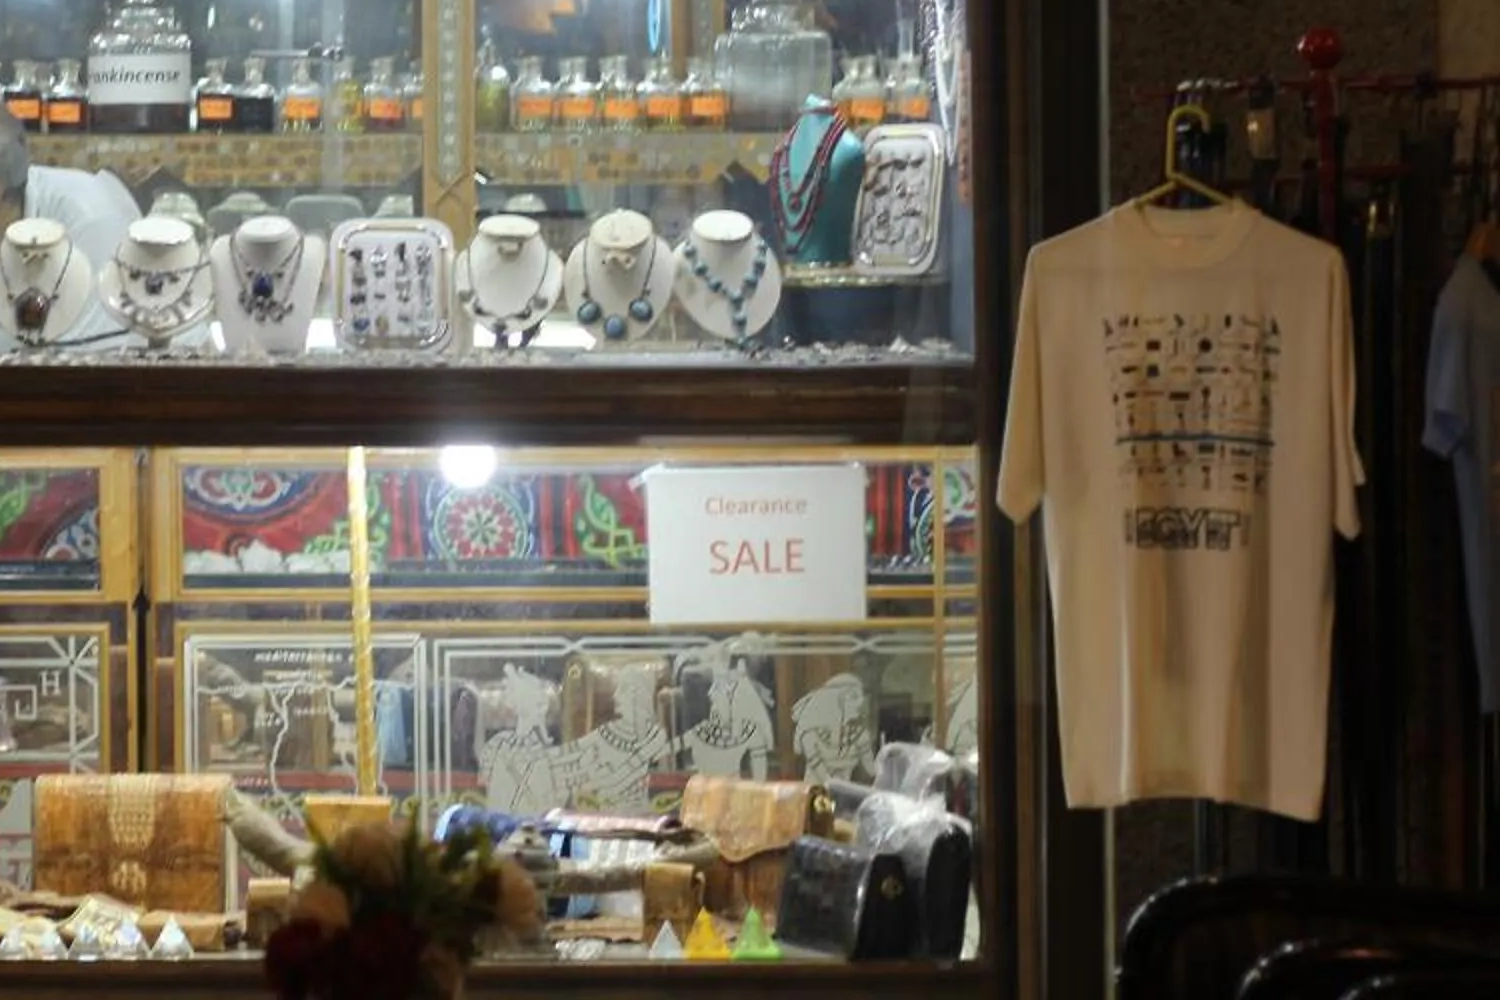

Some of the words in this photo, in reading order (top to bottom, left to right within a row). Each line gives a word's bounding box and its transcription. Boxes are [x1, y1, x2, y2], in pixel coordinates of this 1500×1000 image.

[704, 496, 808, 515] Clearance
[709, 537, 805, 575] SALE
[41, 670, 61, 696] H
